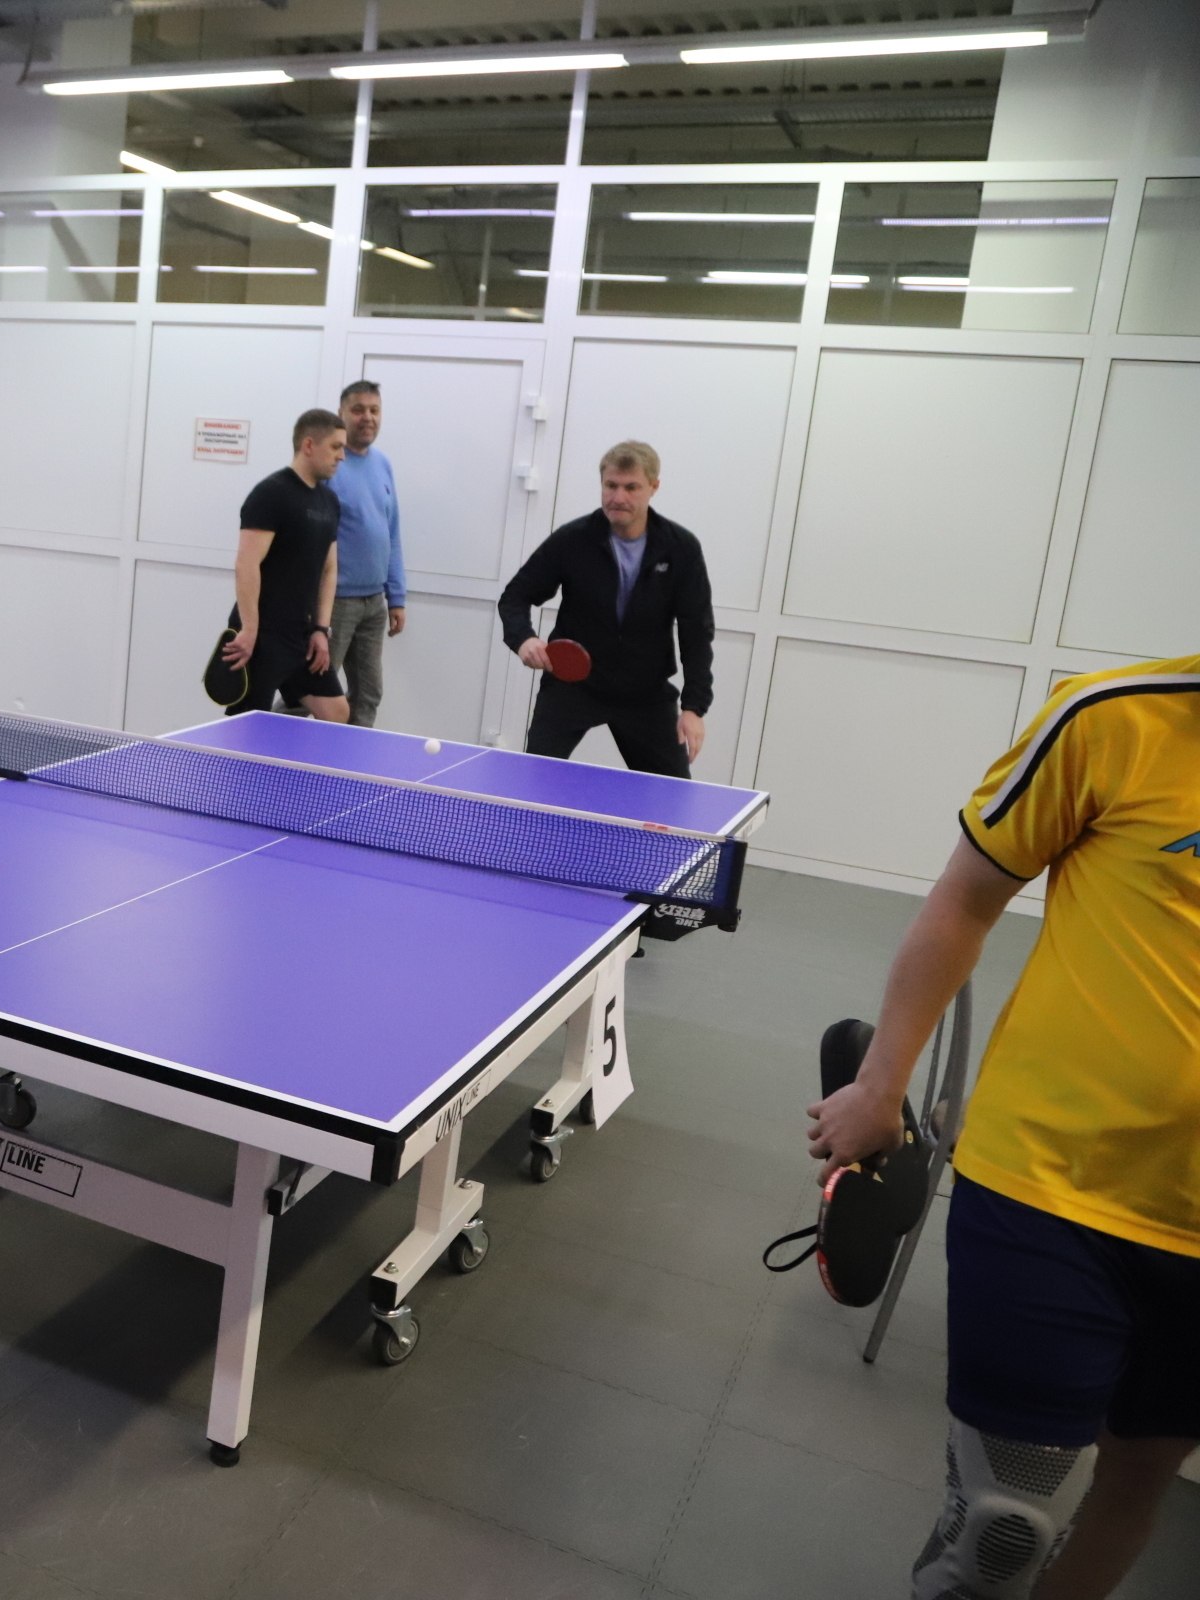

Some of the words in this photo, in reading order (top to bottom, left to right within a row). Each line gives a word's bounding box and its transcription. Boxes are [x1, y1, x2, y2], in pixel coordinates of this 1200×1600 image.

[603, 995, 617, 1077] 5
[435, 1097, 467, 1143] UNIX
[7, 1146, 46, 1174] LINE
